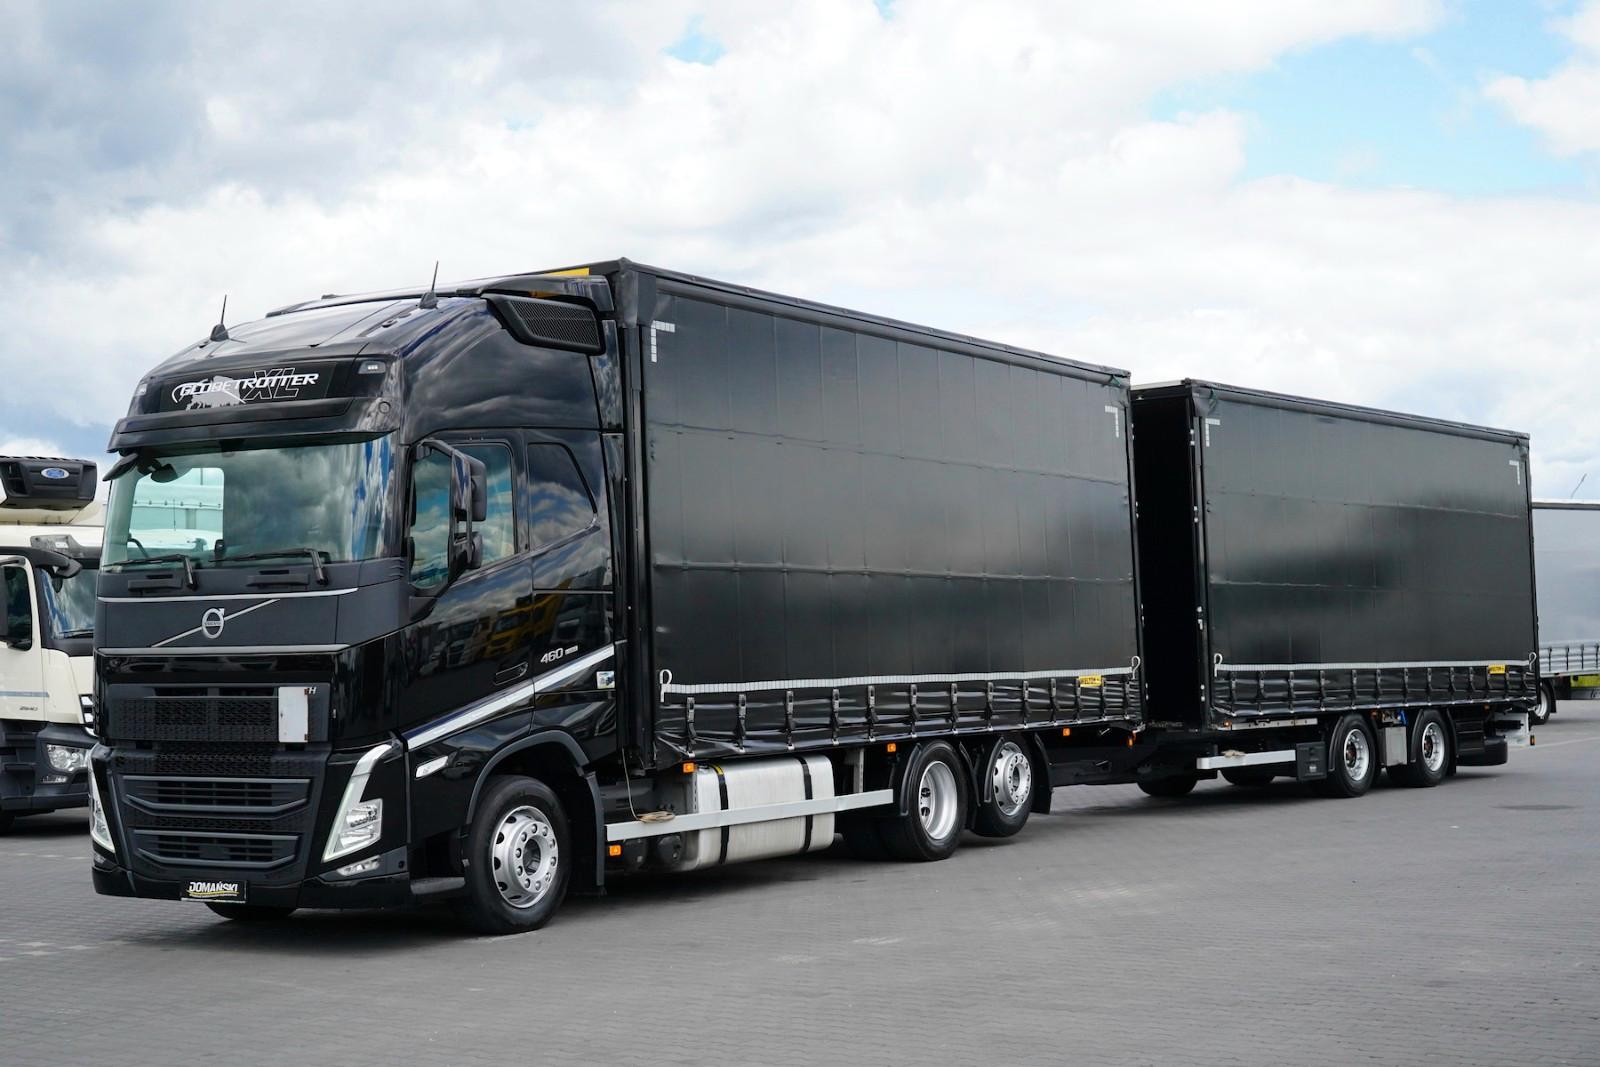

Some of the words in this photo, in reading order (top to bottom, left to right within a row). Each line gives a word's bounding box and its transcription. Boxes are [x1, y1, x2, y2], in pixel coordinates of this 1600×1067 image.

[179, 373, 320, 396] GLOBETROTTER
[244, 368, 300, 401] XL
[540, 647, 564, 664] 460
[188, 881, 239, 893] DOMAŃSKI
